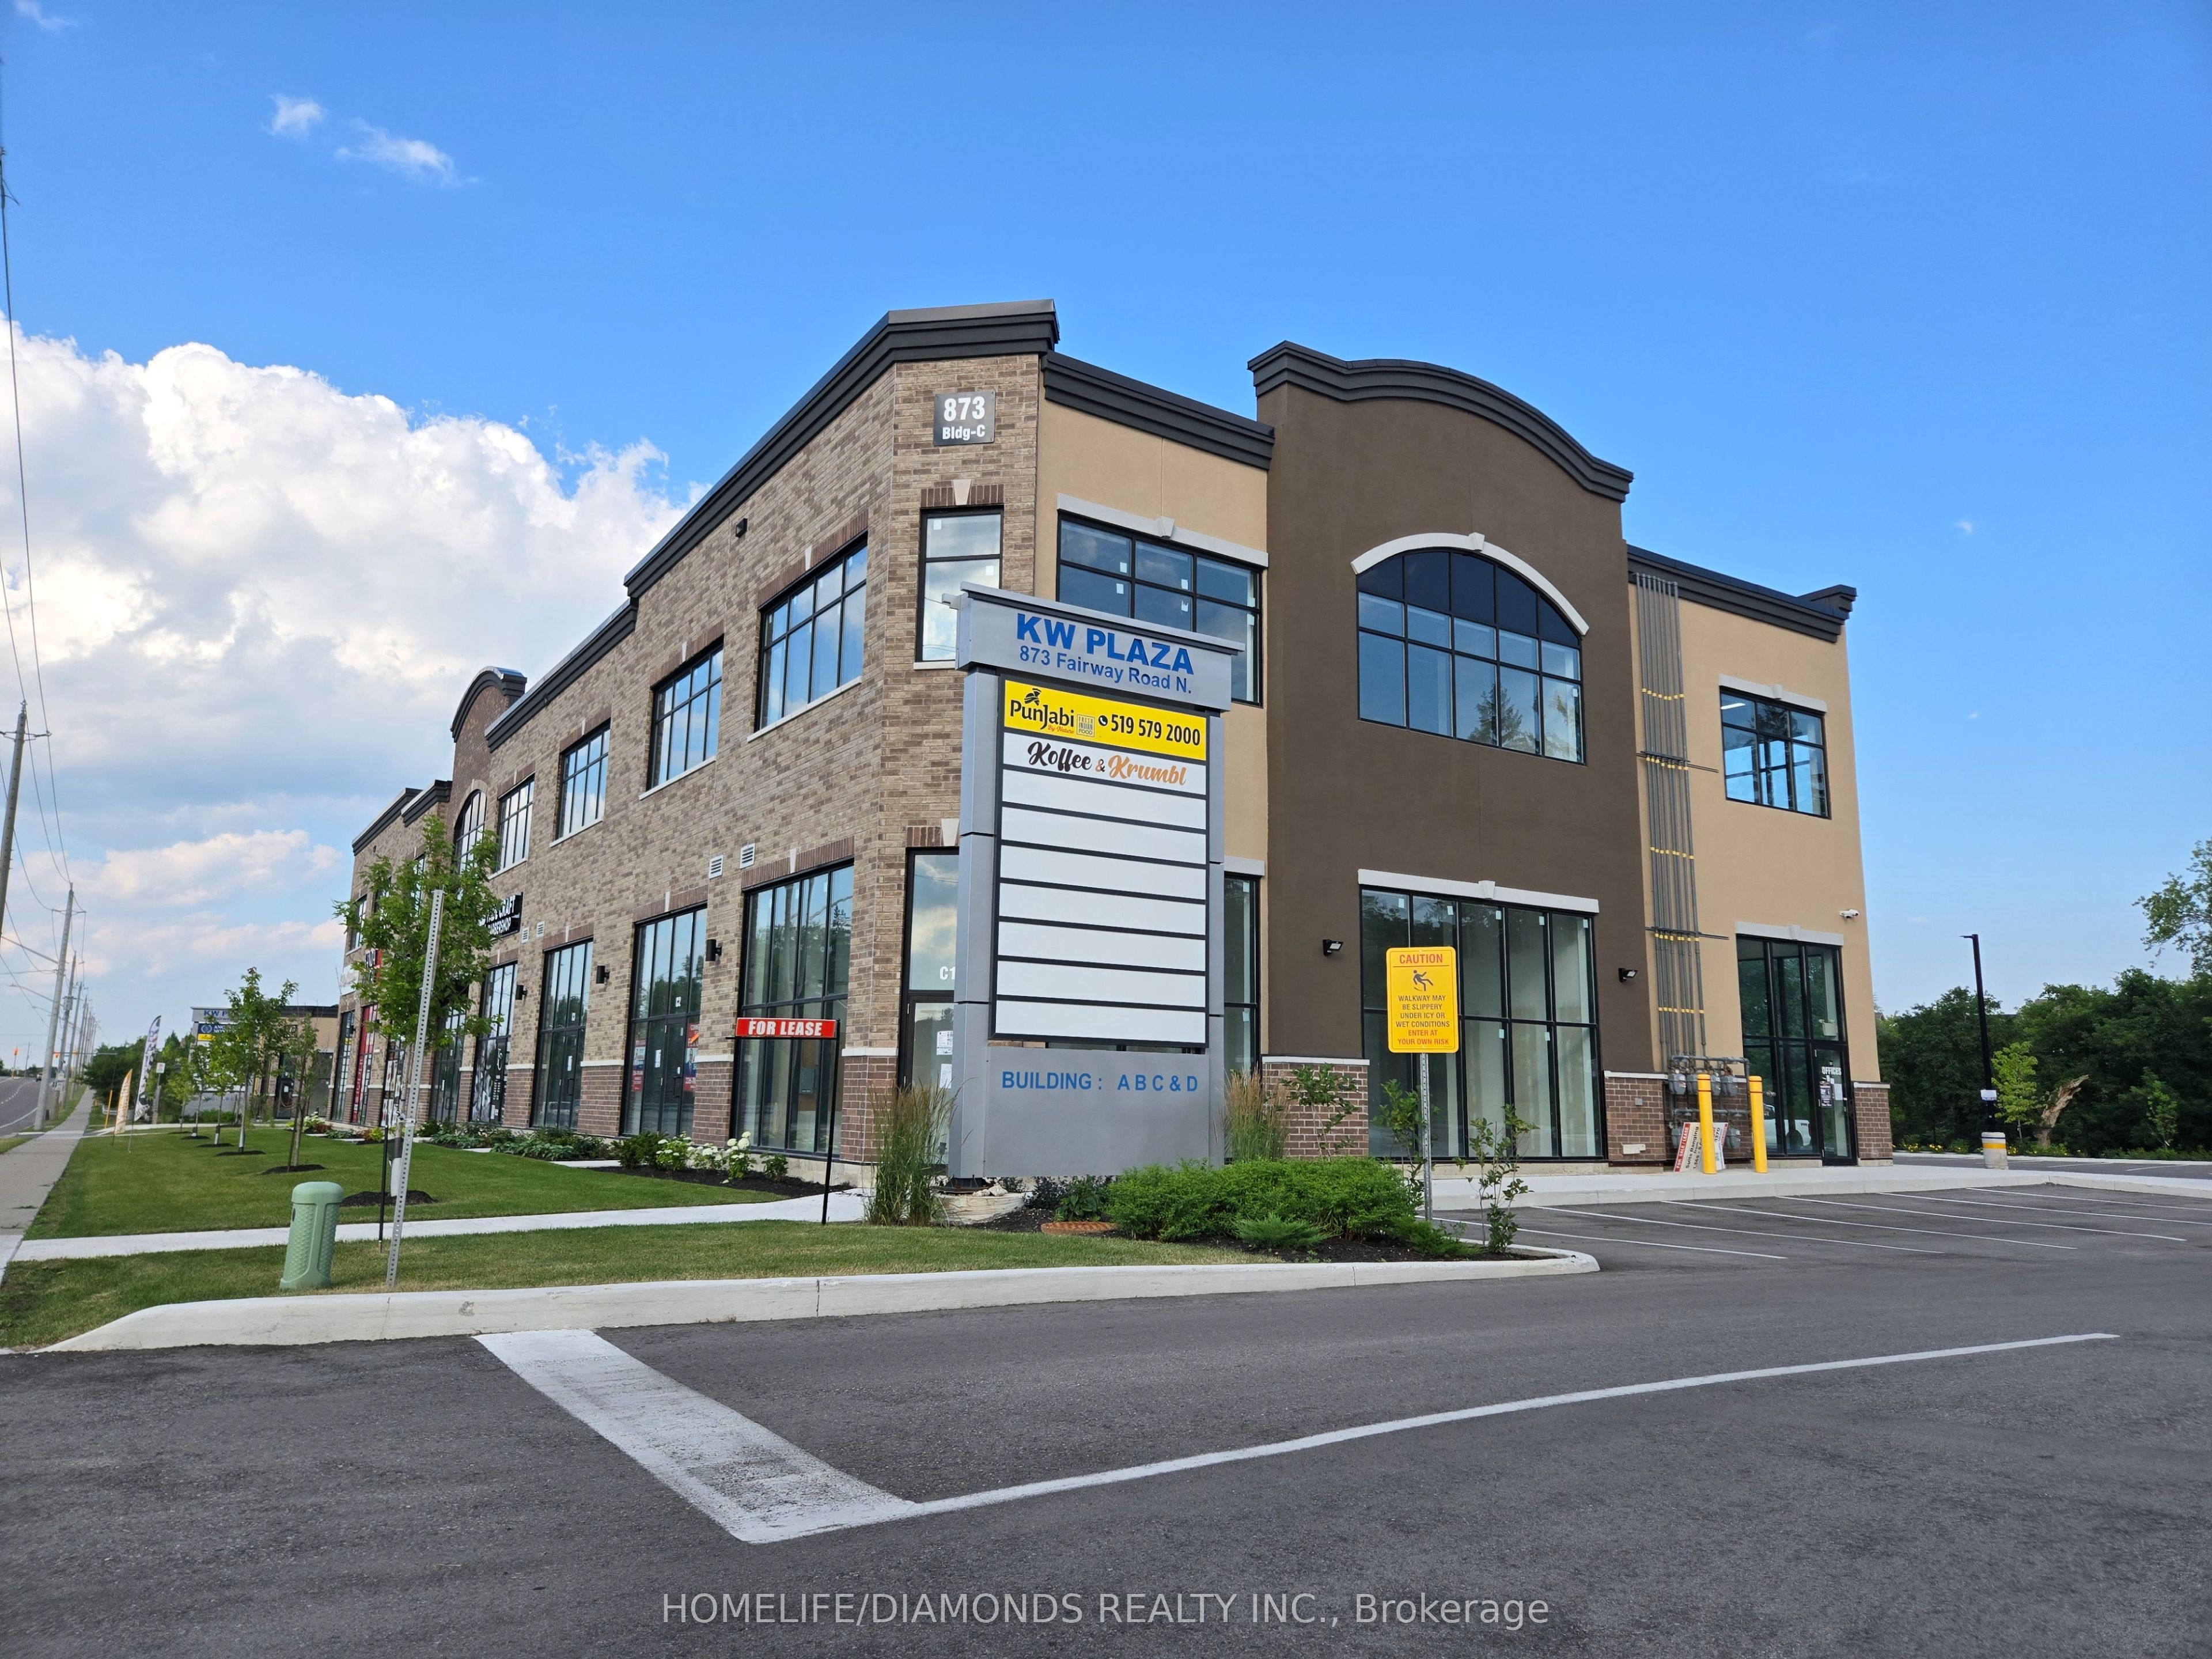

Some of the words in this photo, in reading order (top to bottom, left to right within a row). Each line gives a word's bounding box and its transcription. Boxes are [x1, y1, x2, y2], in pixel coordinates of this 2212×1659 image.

[944, 396, 985, 422] 873
[942, 425, 986, 441] Bldg-C
[1017, 613, 1076, 650] KW
[1086, 629, 1194, 675] PLAZA
[1020, 645, 1050, 666] 873
[1056, 653, 1124, 684] Fairway
[1129, 667, 1171, 690] Road
[1177, 676, 1192, 694] N.
[1078, 722, 1093, 730] INDIAN
[1111, 714, 1134, 735] 519
[1139, 718, 1162, 740] 579
[1166, 724, 1200, 747] 2000
[1027, 741, 1092, 771] Koffee
[1095, 759, 1105, 772] &
[1108, 754, 1187, 786] Krumbl
[1399, 953, 1443, 964] CAUTION
[749, 1021, 776, 1035] FOR
[780, 1021, 822, 1036] LEASE
[1821, 1066, 1842, 1075] OFFICES
